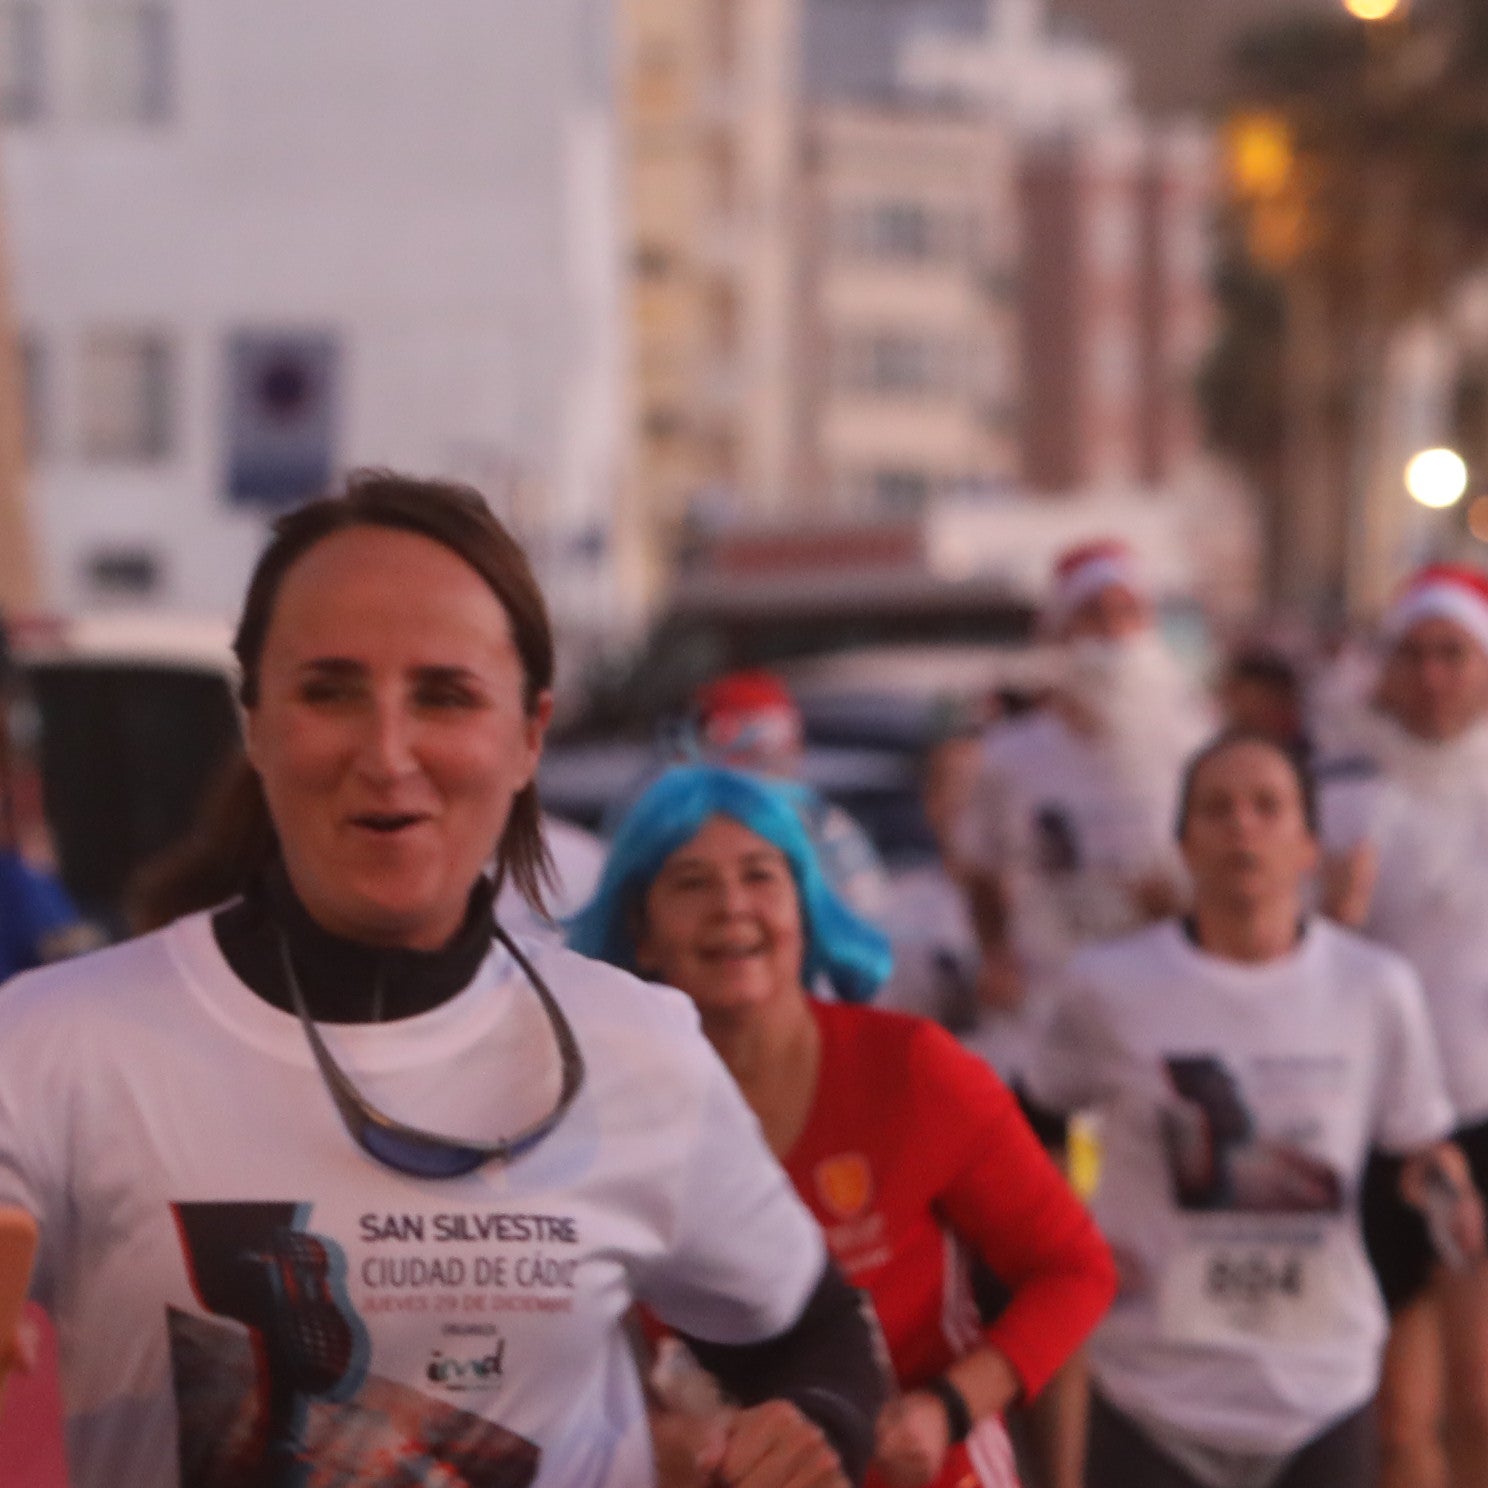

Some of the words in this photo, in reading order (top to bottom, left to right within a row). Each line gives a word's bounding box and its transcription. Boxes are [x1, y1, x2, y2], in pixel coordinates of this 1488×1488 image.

[359, 1213, 425, 1243] SAN
[432, 1212, 579, 1244] SILVESTRE
[362, 1256, 466, 1289] CIUDAD
[474, 1256, 508, 1289] DE
